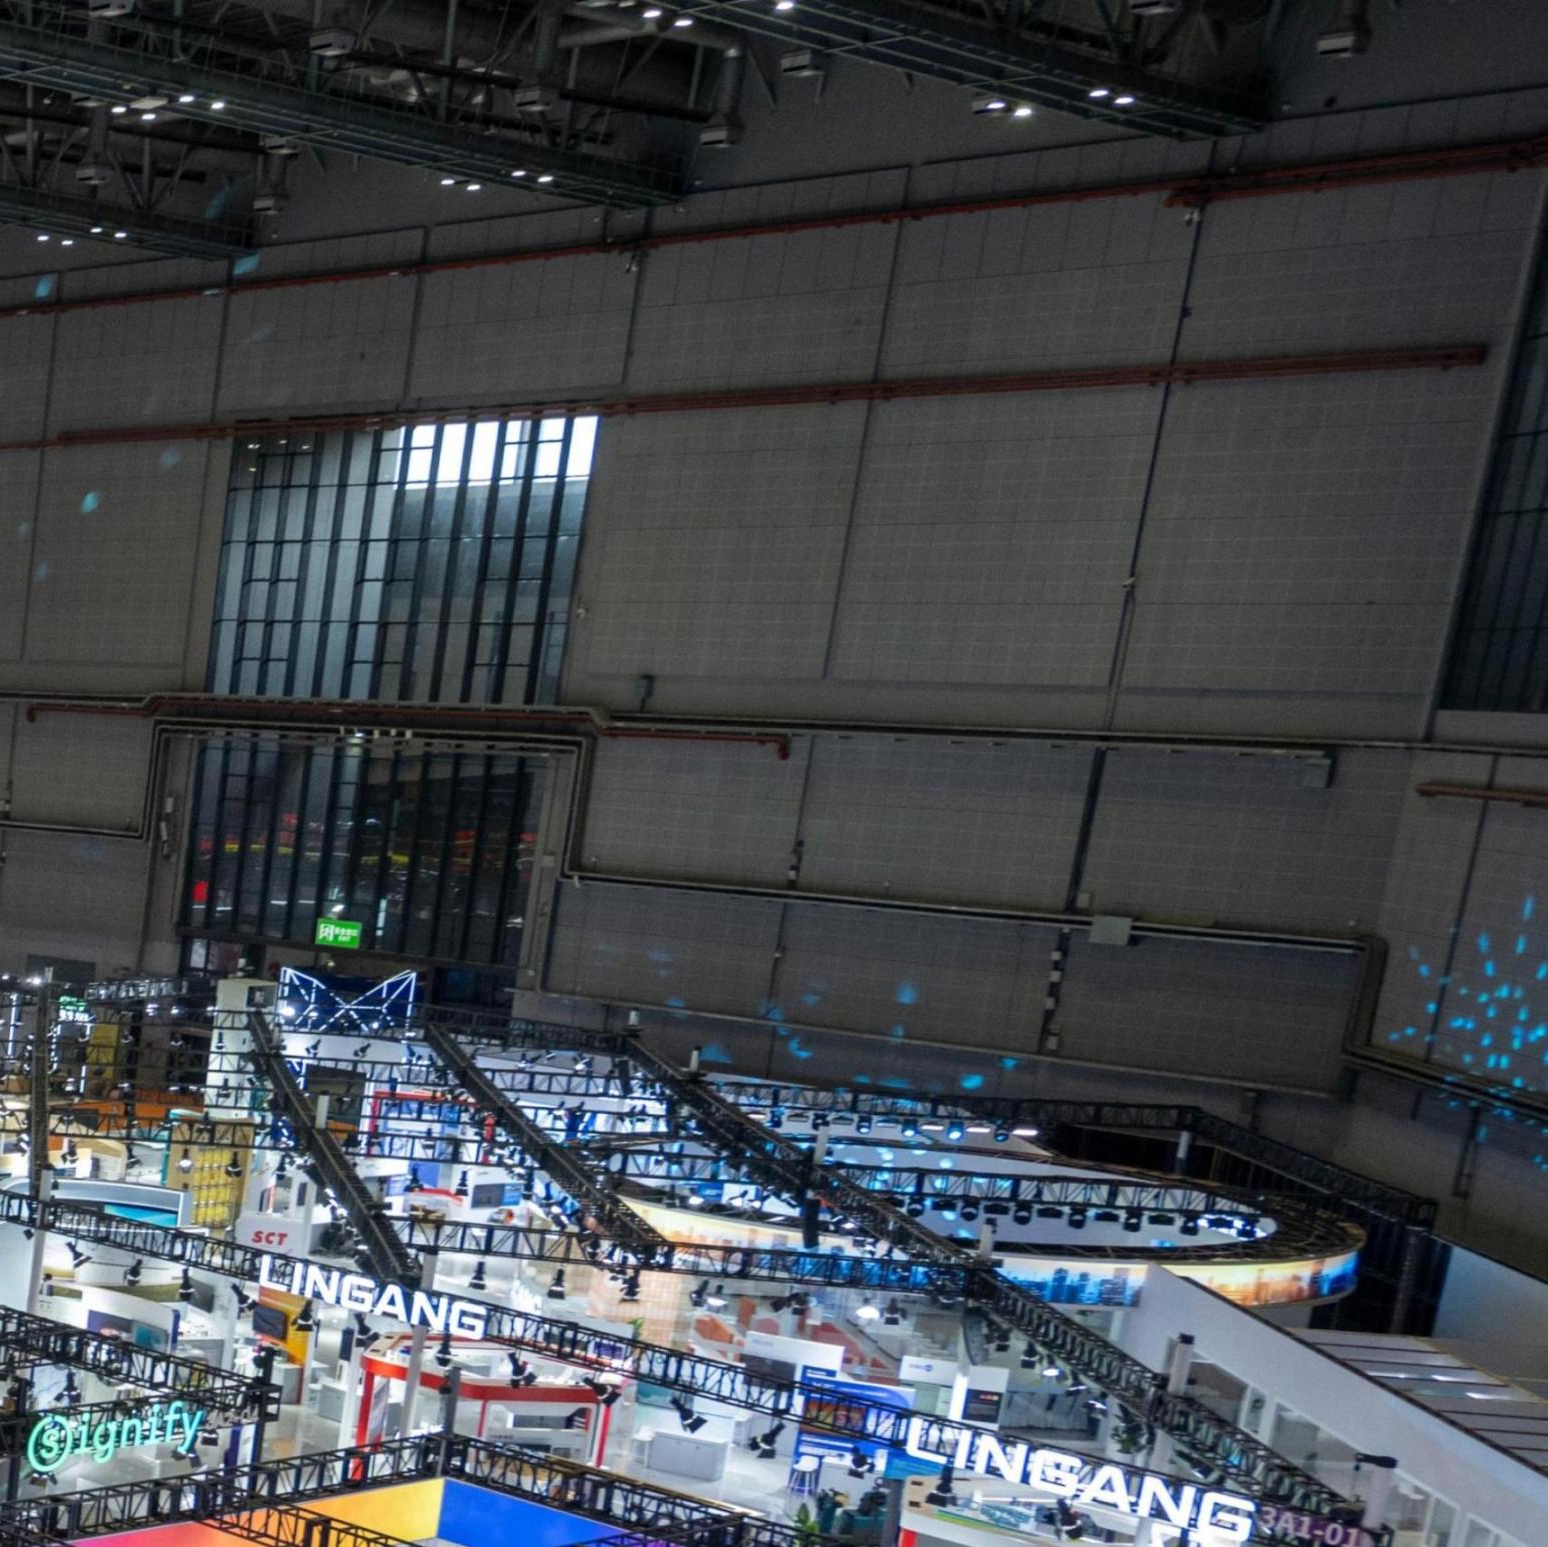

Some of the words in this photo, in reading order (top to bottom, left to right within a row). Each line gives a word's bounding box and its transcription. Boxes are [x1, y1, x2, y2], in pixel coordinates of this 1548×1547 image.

[251, 1230, 288, 1247] SCT
[260, 1254, 488, 1338] LINGANG
[908, 1416, 1257, 1543] LINGANG
